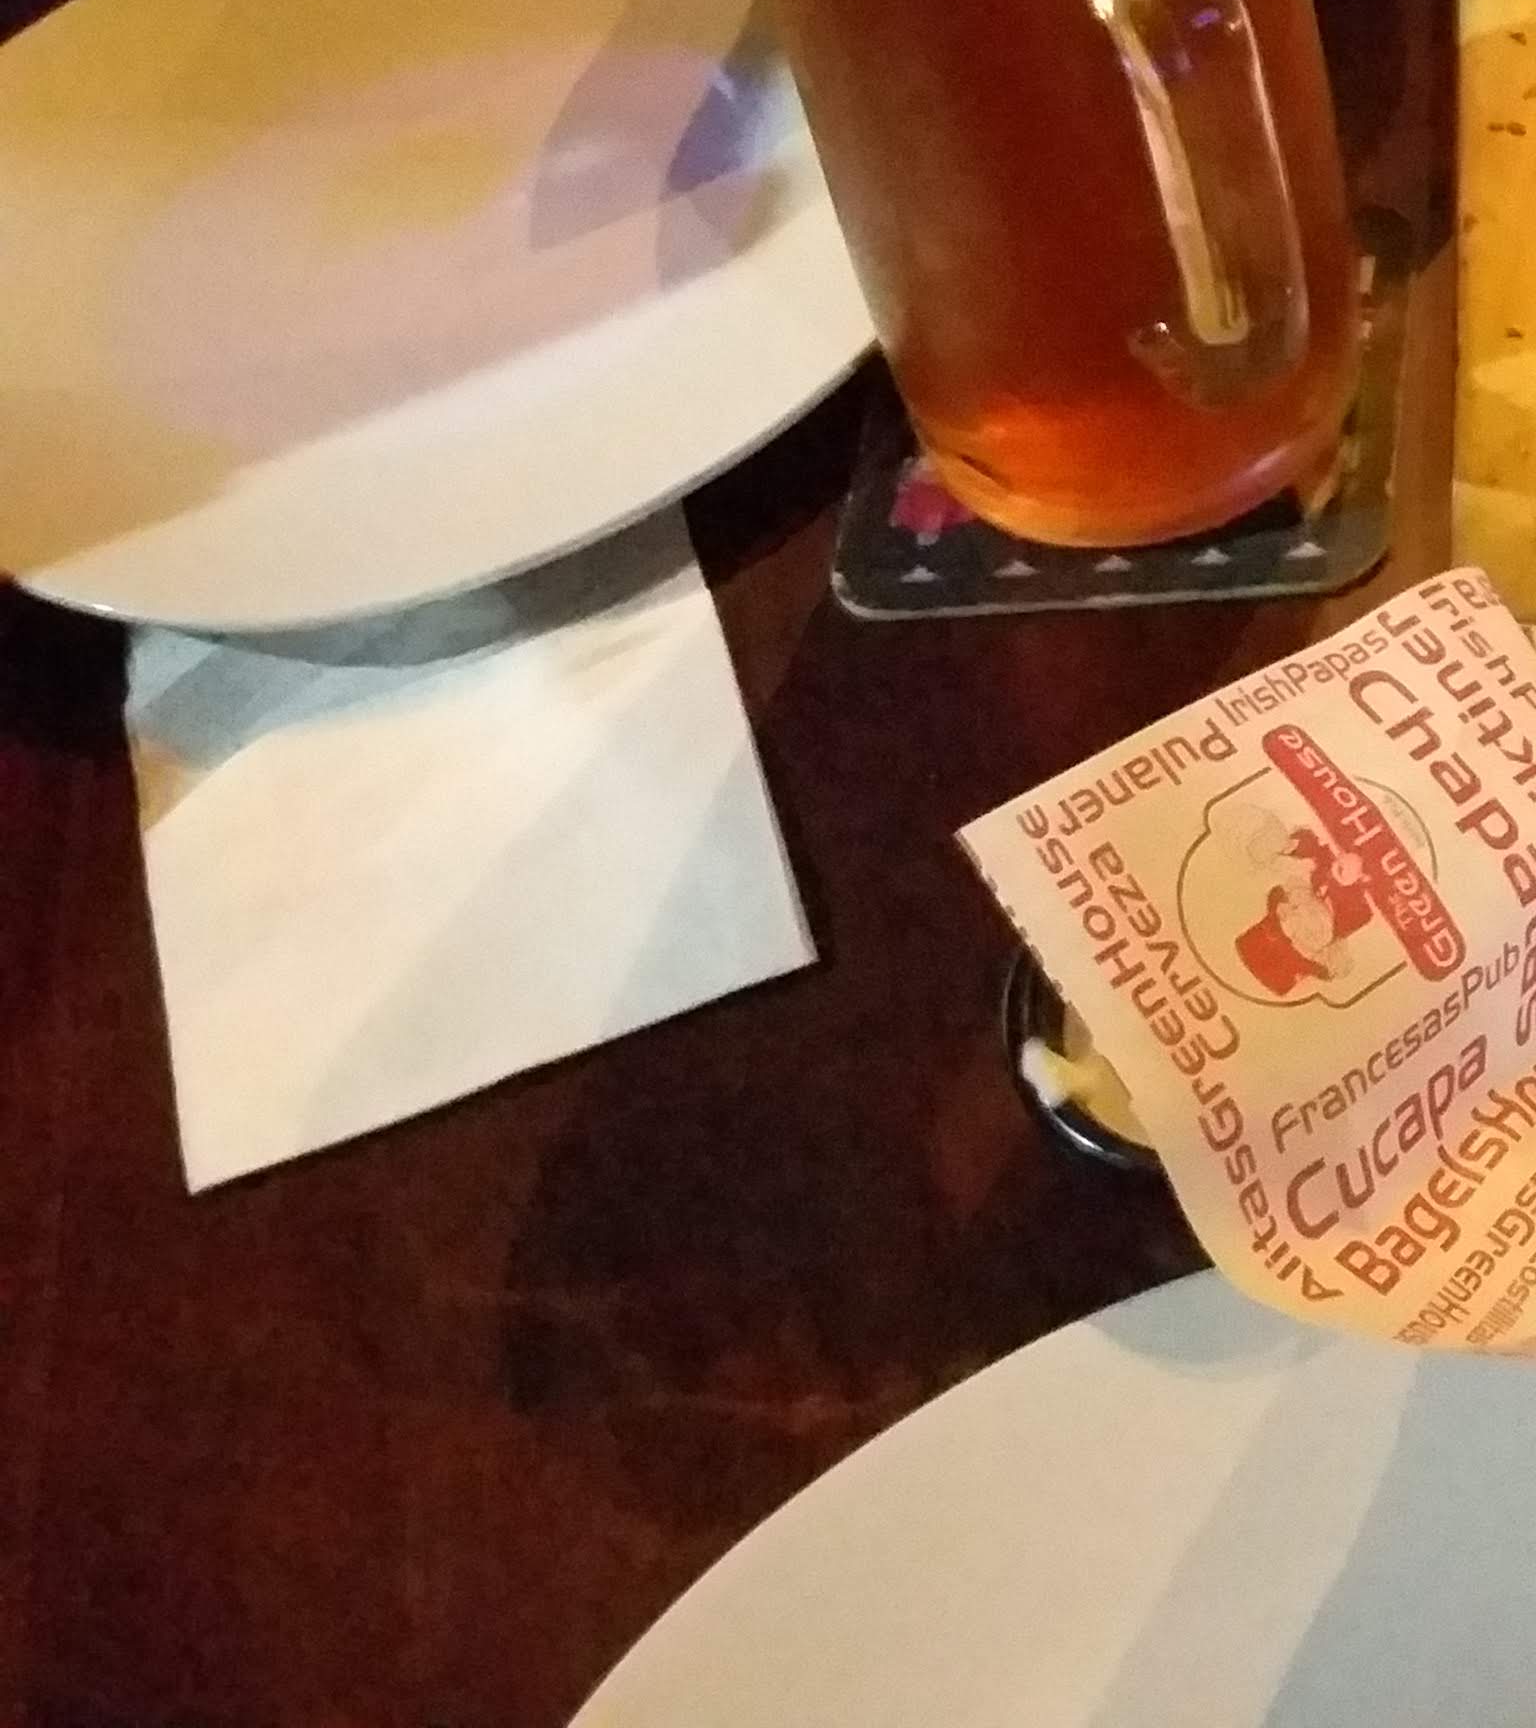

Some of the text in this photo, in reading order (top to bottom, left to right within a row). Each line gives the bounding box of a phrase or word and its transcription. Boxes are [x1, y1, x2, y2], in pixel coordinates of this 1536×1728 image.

[1215, 628, 1391, 728] IrishPapas
[1058, 717, 1239, 838] Pulaner
[1277, 731, 1382, 848] House
[1088, 840, 1242, 1061] Cerveza
[1379, 850, 1458, 970] Green
[1270, 941, 1522, 1155] FrancesasPub
[1284, 1033, 1489, 1241] Cucapa
